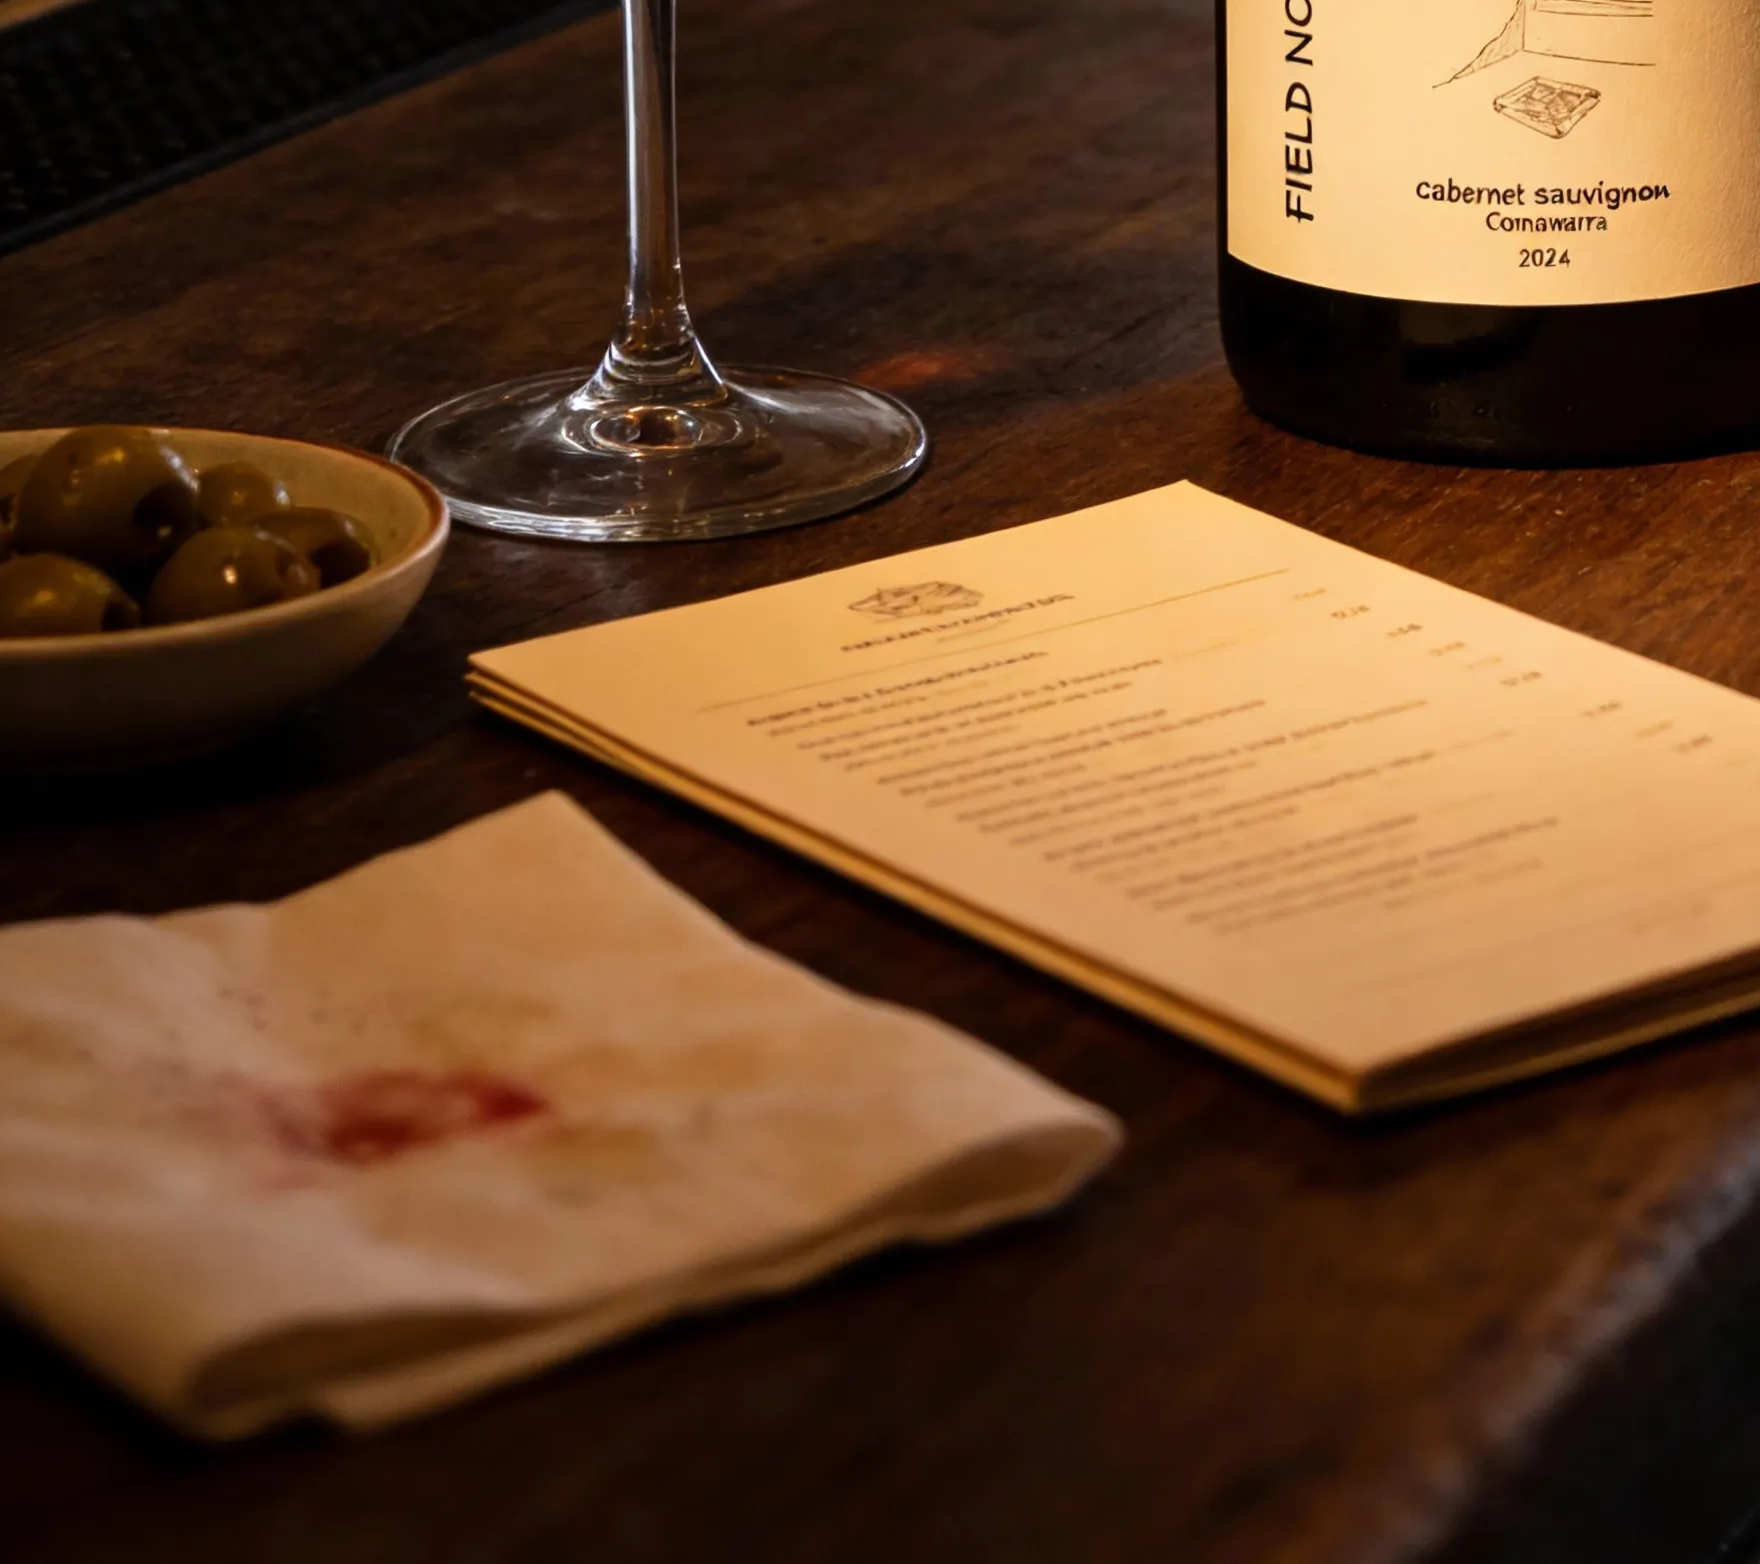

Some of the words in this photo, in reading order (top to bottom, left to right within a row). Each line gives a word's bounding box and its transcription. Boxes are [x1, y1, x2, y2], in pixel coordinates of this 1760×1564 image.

[1284, 82, 1315, 223] FIELD
[1533, 180, 1671, 211] sauvignon
[1518, 248, 1571, 268] 2024
